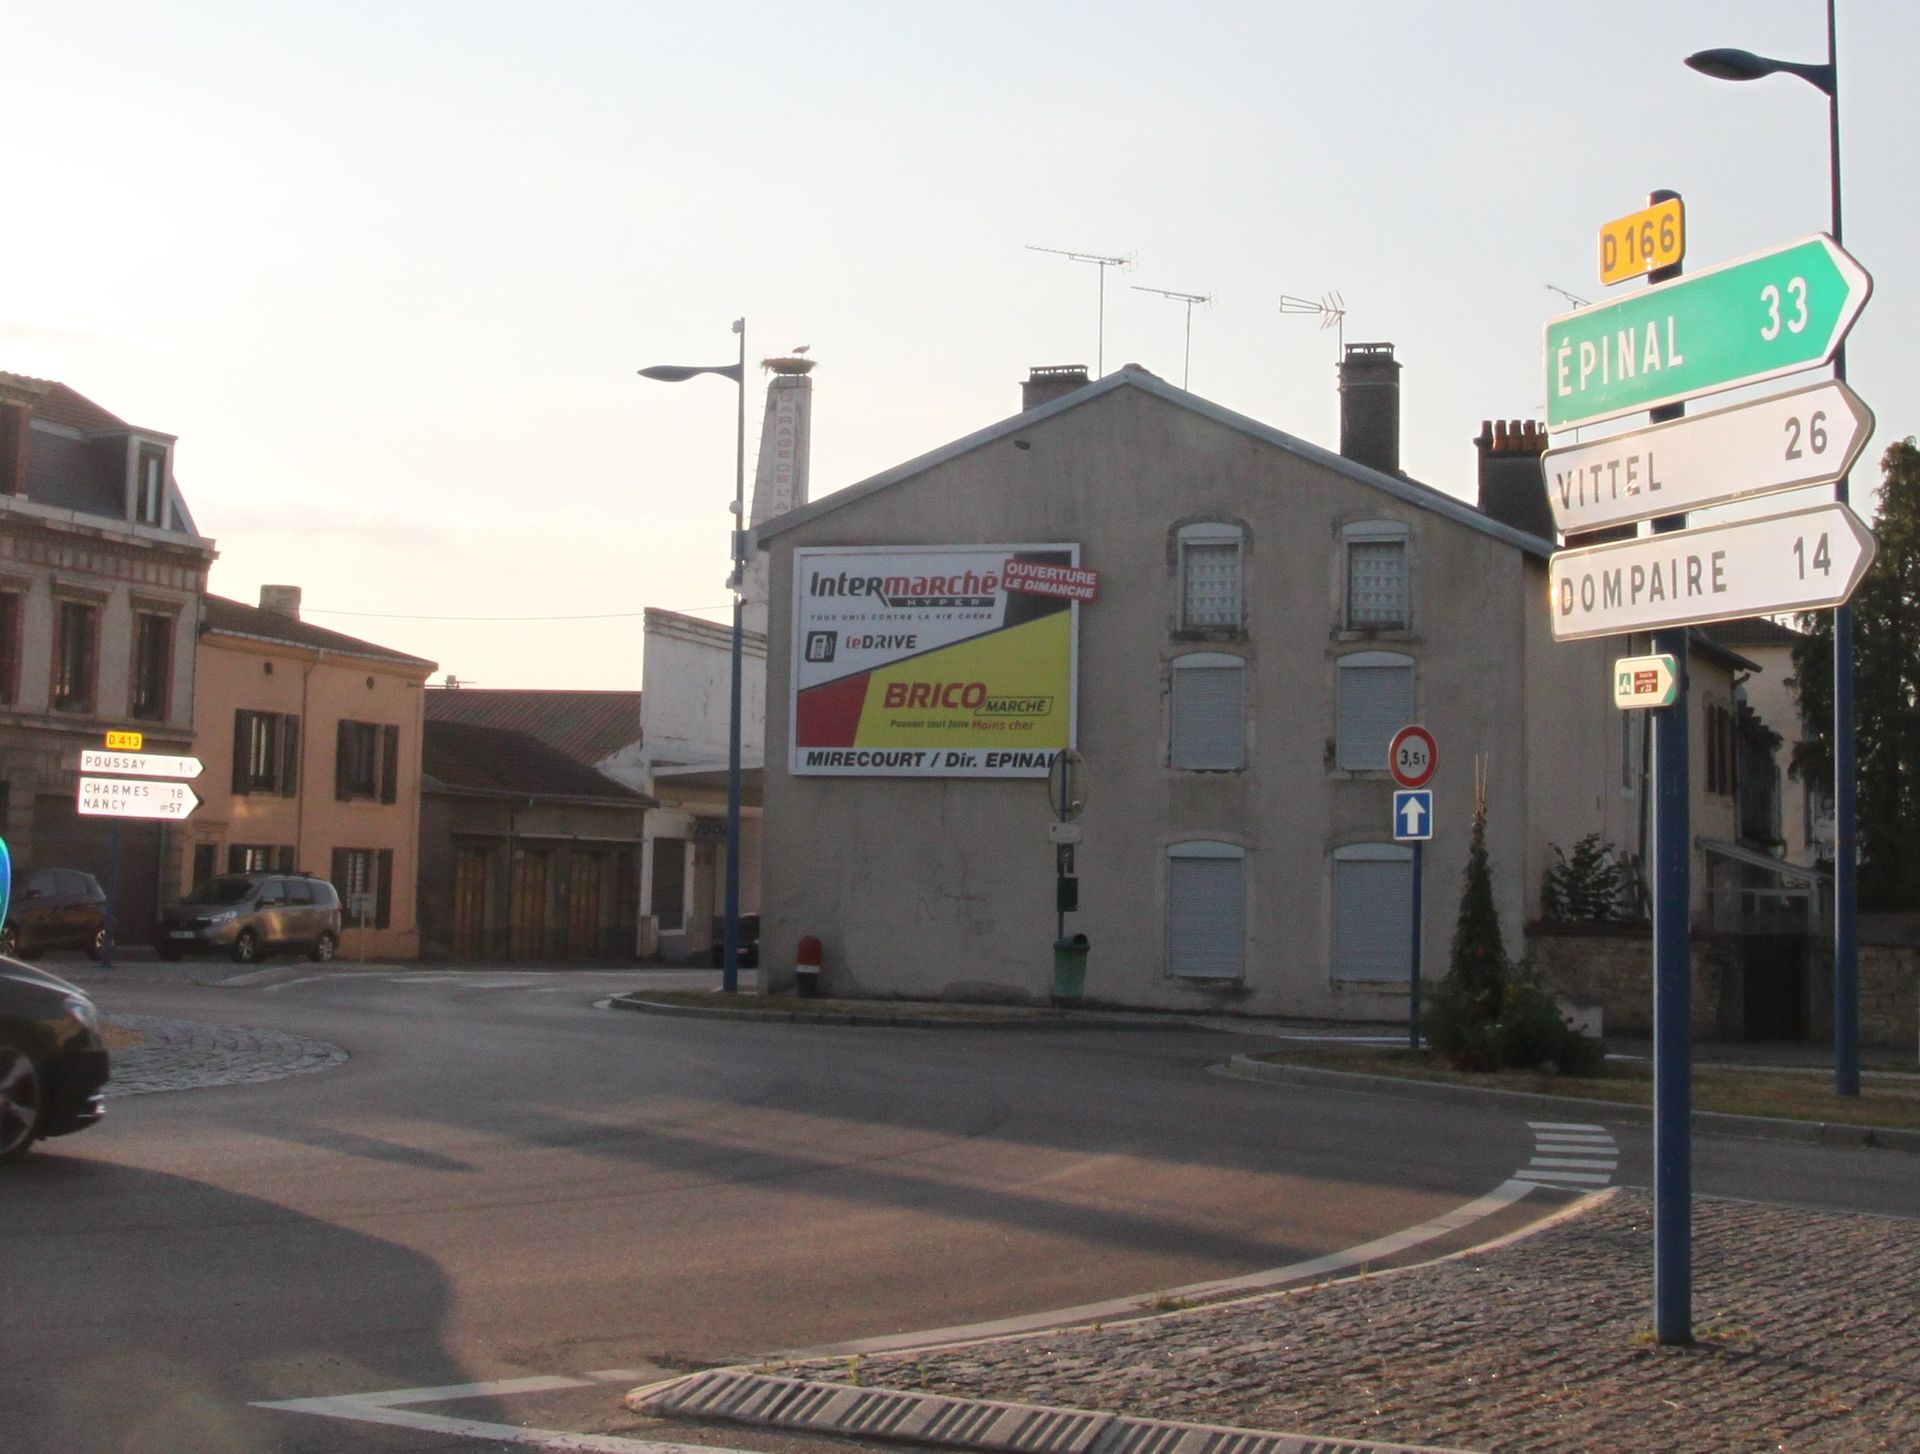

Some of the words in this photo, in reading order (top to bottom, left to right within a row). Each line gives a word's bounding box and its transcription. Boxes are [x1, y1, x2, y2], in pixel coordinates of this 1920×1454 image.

[1557, 315, 1684, 397] ÉPINAL
[1760, 276, 1808, 341] 33
[1556, 452, 1662, 510] VITTEL
[1784, 410, 1828, 461] 26
[1007, 562, 1097, 584] OUVERTURE
[1560, 550, 1727, 617] DOMPAIRE
[1793, 532, 1832, 580] 14
[1004, 577, 1022, 588] LE
[1024, 580, 1095, 598] DIMANCHE
[906, 599, 981, 607] HYPER
[884, 682, 987, 709] BRICO
[985, 699, 1046, 713] MARCHÉ
[972, 720, 1005, 731] Moins
[1008, 719, 1035, 731] cher
[85, 756, 146, 769] POUSSAY
[806, 752, 926, 767] MIRECOURT
[945, 752, 978, 768] Dir.
[84, 783, 149, 797] CHARMES
[171, 789, 183, 799] 18
[83, 798, 127, 810] NANCY
